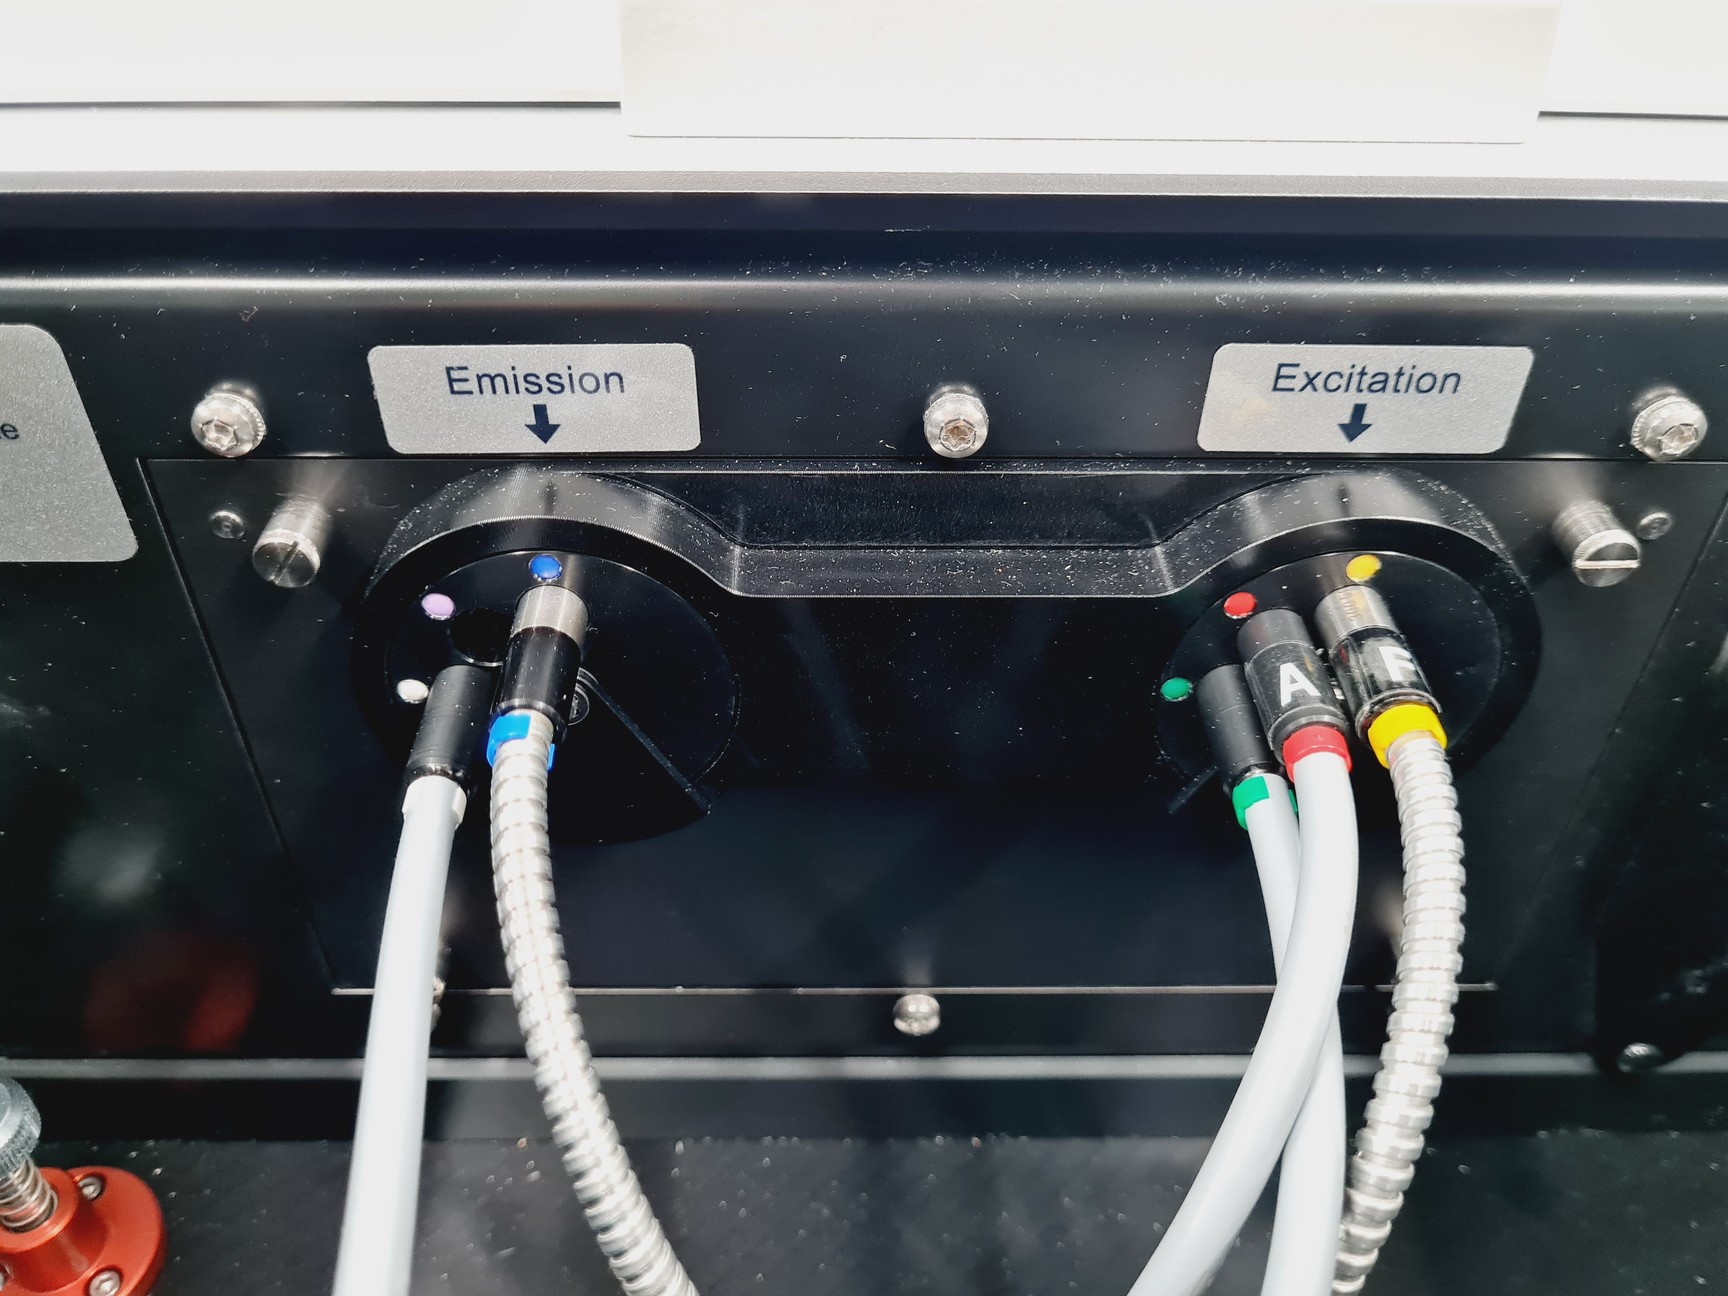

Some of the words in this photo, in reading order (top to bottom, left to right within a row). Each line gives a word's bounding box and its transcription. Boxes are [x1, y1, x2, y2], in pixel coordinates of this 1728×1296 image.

[445, 365, 625, 395] Emission
[1271, 363, 1461, 394] Excitation
[0, 423, 19, 440] e
[1279, 662, 1322, 707] A
